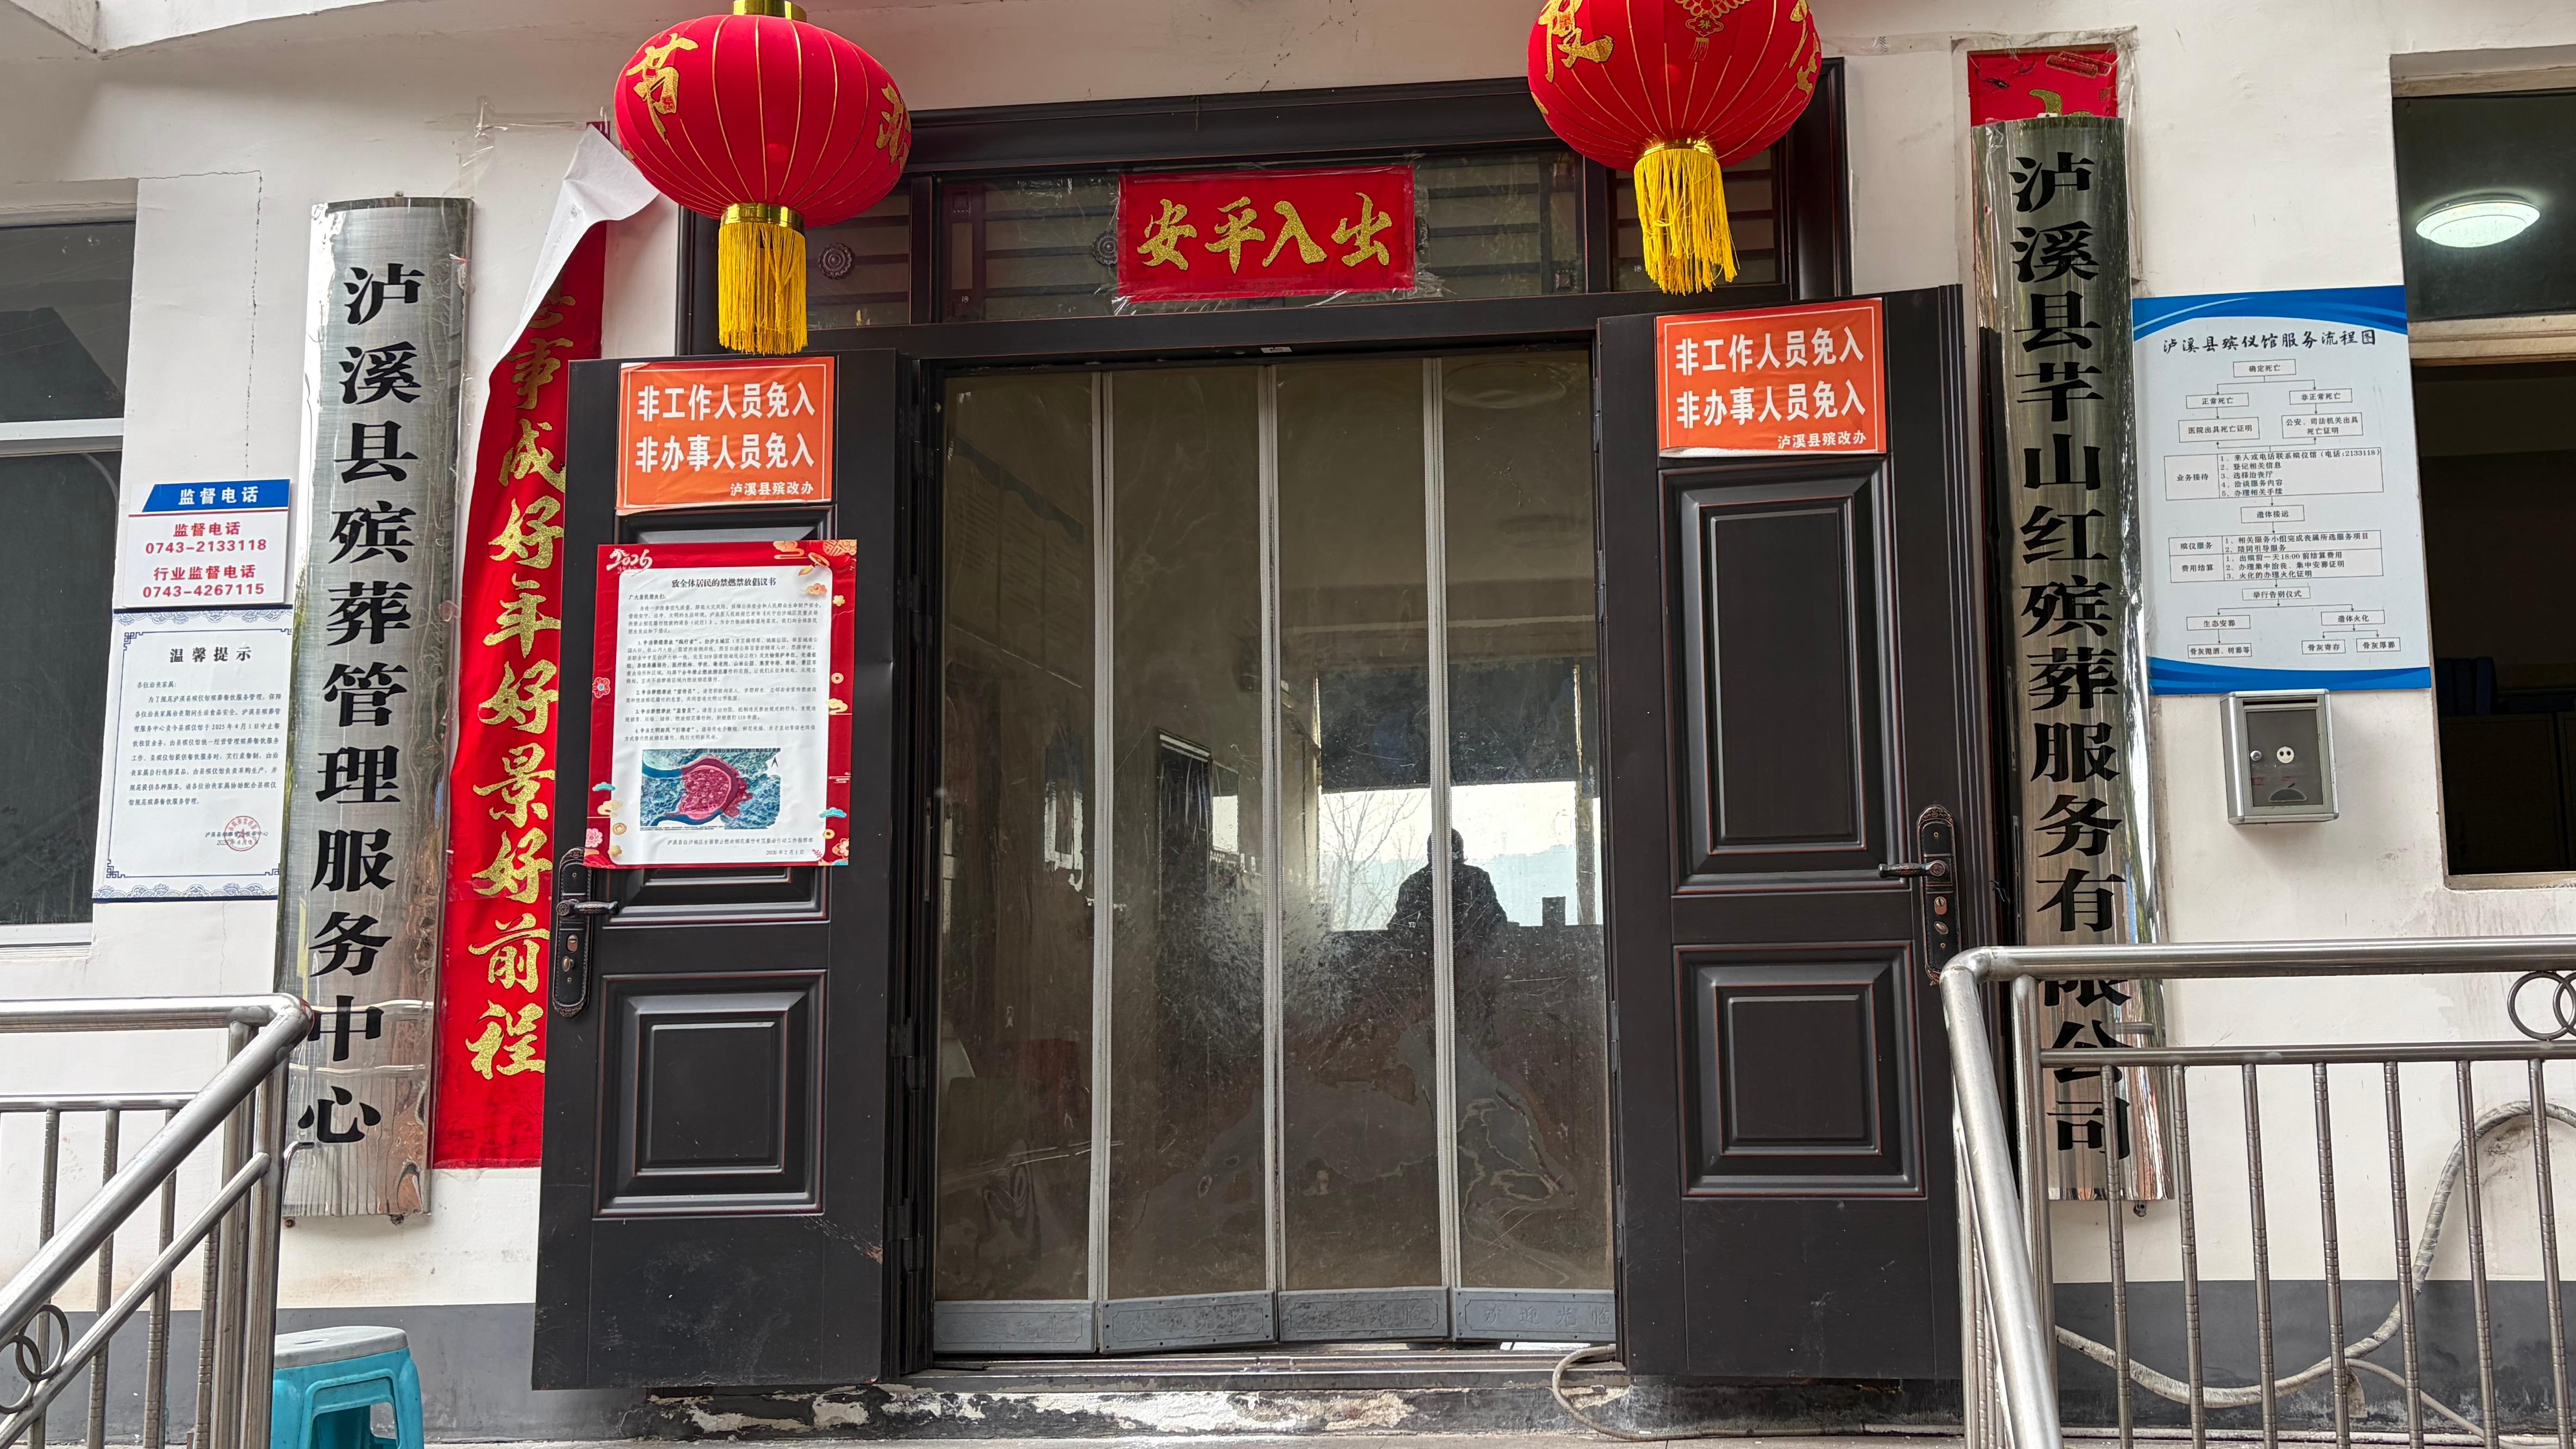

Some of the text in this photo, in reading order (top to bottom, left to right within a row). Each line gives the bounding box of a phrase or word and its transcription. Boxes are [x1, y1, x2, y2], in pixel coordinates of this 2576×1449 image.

[2163, 329, 2376, 354] 泸溪县殡仪馆服务流程图
[1675, 326, 1864, 376] 非工作人员免入
[2249, 364, 2280, 372] 确定死亡
[637, 381, 815, 422] 非工作人员免入
[1676, 379, 1866, 429] 非办事人员免入
[2202, 396, 2234, 405] 正常死亡
[2301, 392, 2341, 401] 非正常死亡
[2188, 424, 2253, 434] 医院出具死亡证明
[2307, 427, 2339, 435] 死亡证明
[1778, 430, 1867, 449] 泸溪县殡改办
[635, 432, 814, 473] 非办事人员免入
[2177, 473, 2209, 482] 业务接待
[178, 486, 259, 505] 监督电话
[730, 481, 814, 497] 泸溪县殡改办
[2256, 510, 2290, 519] 遗体接运
[173, 521, 241, 537] 监督电话
[145, 539, 267, 554] 0743-2133118
[153, 564, 256, 581] 行业监督电话
[2181, 564, 2214, 572] 费用结算
[142, 583, 264, 598] 0743-4267115
[672, 577, 777, 589] 致全体居民的禁燃禁放倡议书
[2253, 590, 2302, 598] 举行告别仪式
[2203, 620, 2236, 628] 生态安葬
[2337, 615, 2369, 623] 遗体火化
[170, 645, 252, 663] 温馨提示
[298, 263, 425, 1142] 泸溪县殡葬管理服务中心
[1484, 1303, 1611, 1327] 欢迎光临
